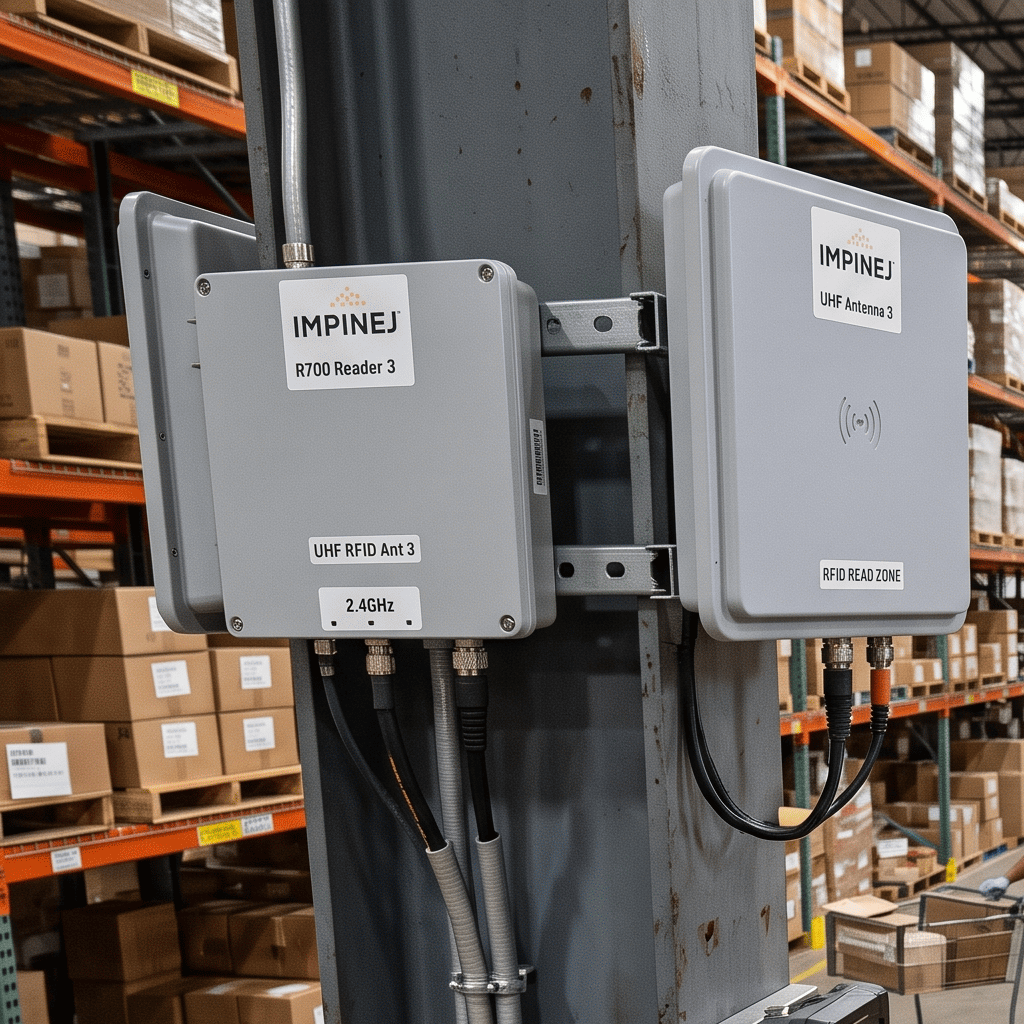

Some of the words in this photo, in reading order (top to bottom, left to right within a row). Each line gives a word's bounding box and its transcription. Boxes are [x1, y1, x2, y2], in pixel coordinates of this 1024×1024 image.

[820, 244, 893, 281] IMPINEJ
[820, 291, 843, 309] UHF
[844, 297, 885, 318] Antenna
[886, 306, 893, 320] 3
[293, 311, 398, 338] IMPINEJ
[295, 362, 331, 378] R700
[334, 360, 383, 376] Reader
[386, 359, 396, 374] 3
[313, 543, 341, 558] UHF
[345, 542, 377, 557] RFID
[380, 542, 404, 557] Ant
[406, 541, 415, 556] 3
[823, 567, 846, 582] RFID
[848, 568, 874, 582] READ
[875, 568, 901, 582] ZONE
[345, 597, 395, 613] 2.4GHz
